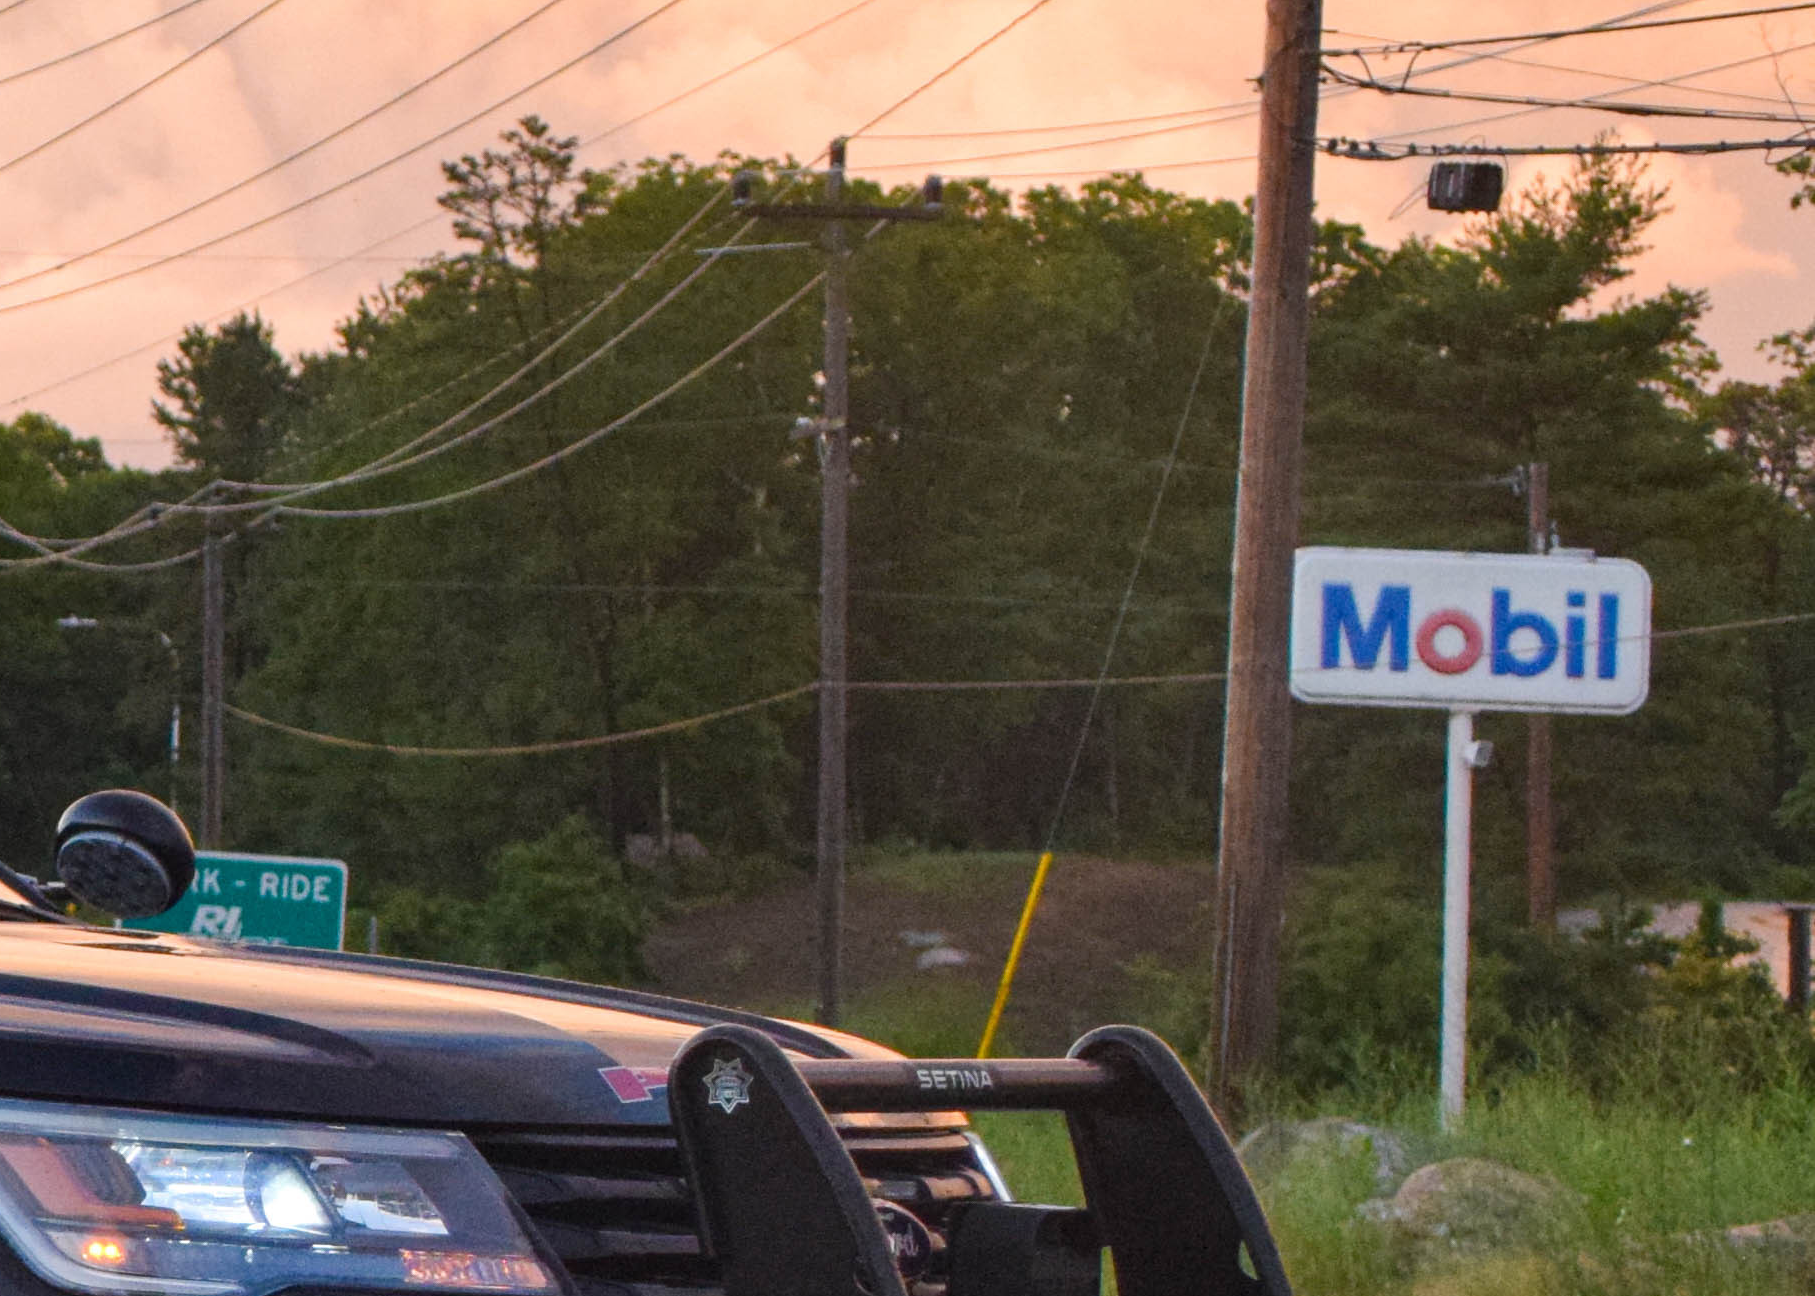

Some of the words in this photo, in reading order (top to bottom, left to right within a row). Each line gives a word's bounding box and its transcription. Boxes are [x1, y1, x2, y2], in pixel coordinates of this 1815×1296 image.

[1320, 582, 1620, 680] Mobil
[259, 872, 332, 903] RIDE
[916, 1069, 994, 1090] SETINA
